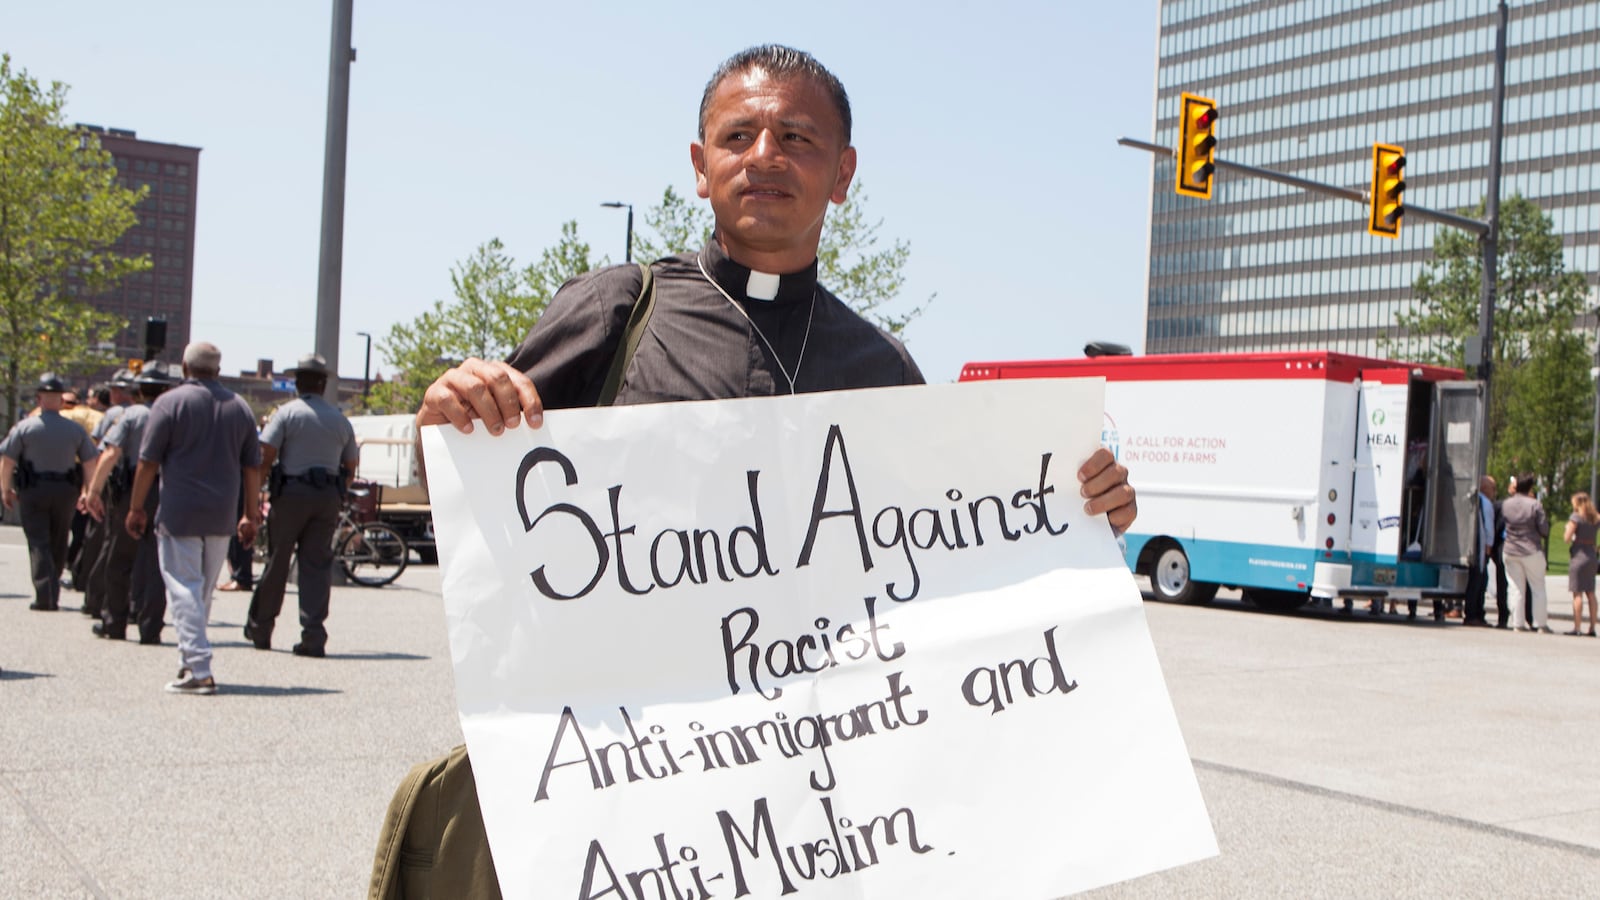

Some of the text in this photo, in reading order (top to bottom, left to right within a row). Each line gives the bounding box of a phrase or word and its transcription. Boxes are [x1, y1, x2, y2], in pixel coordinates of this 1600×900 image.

[1125, 450, 1217, 464] ON FOOD & FARMS
[1126, 436, 1226, 449] A CALL FOR ACTION
[1366, 433, 1399, 445] HEAL
[516, 425, 1068, 602] Stand Against
[721, 596, 905, 699] Racist
[962, 627, 1077, 715] and
